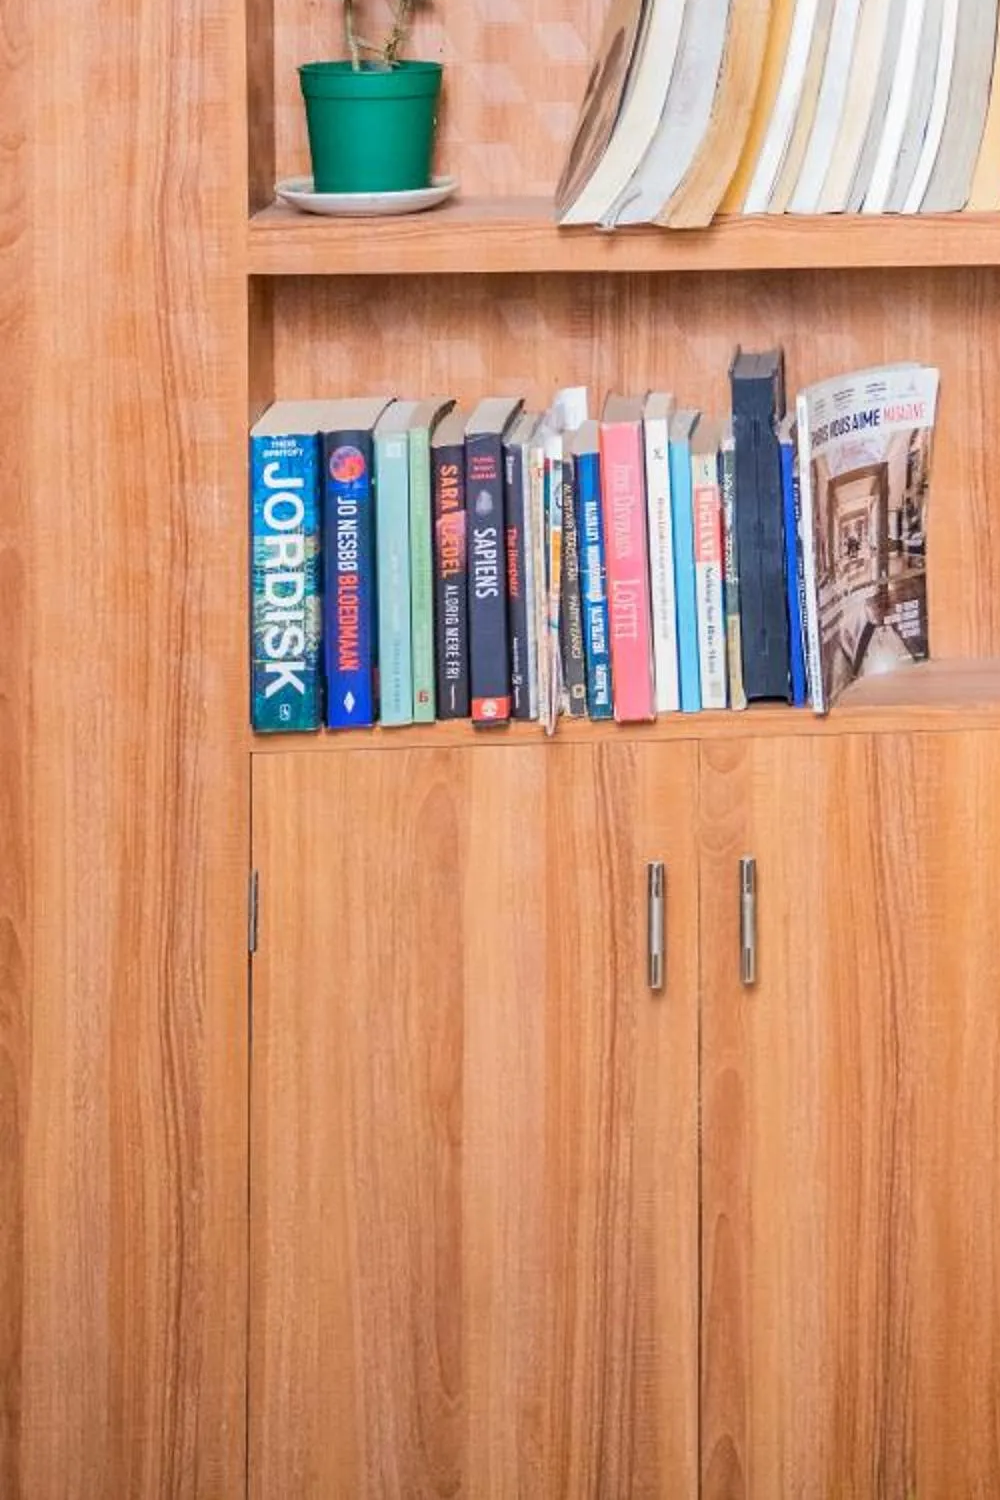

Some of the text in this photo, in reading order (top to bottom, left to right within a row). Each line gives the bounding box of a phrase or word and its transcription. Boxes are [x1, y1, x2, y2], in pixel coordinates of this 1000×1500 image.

[439, 465, 459, 510] SARA
[264, 462, 305, 698] JORDISK
[337, 496, 361, 672] JO NESBØ BLOEDMAAN
[473, 527, 498, 600] SAPIENS
[444, 584, 461, 680] ALDRIG MERE FRI
[613, 578, 641, 641] LOFTET
